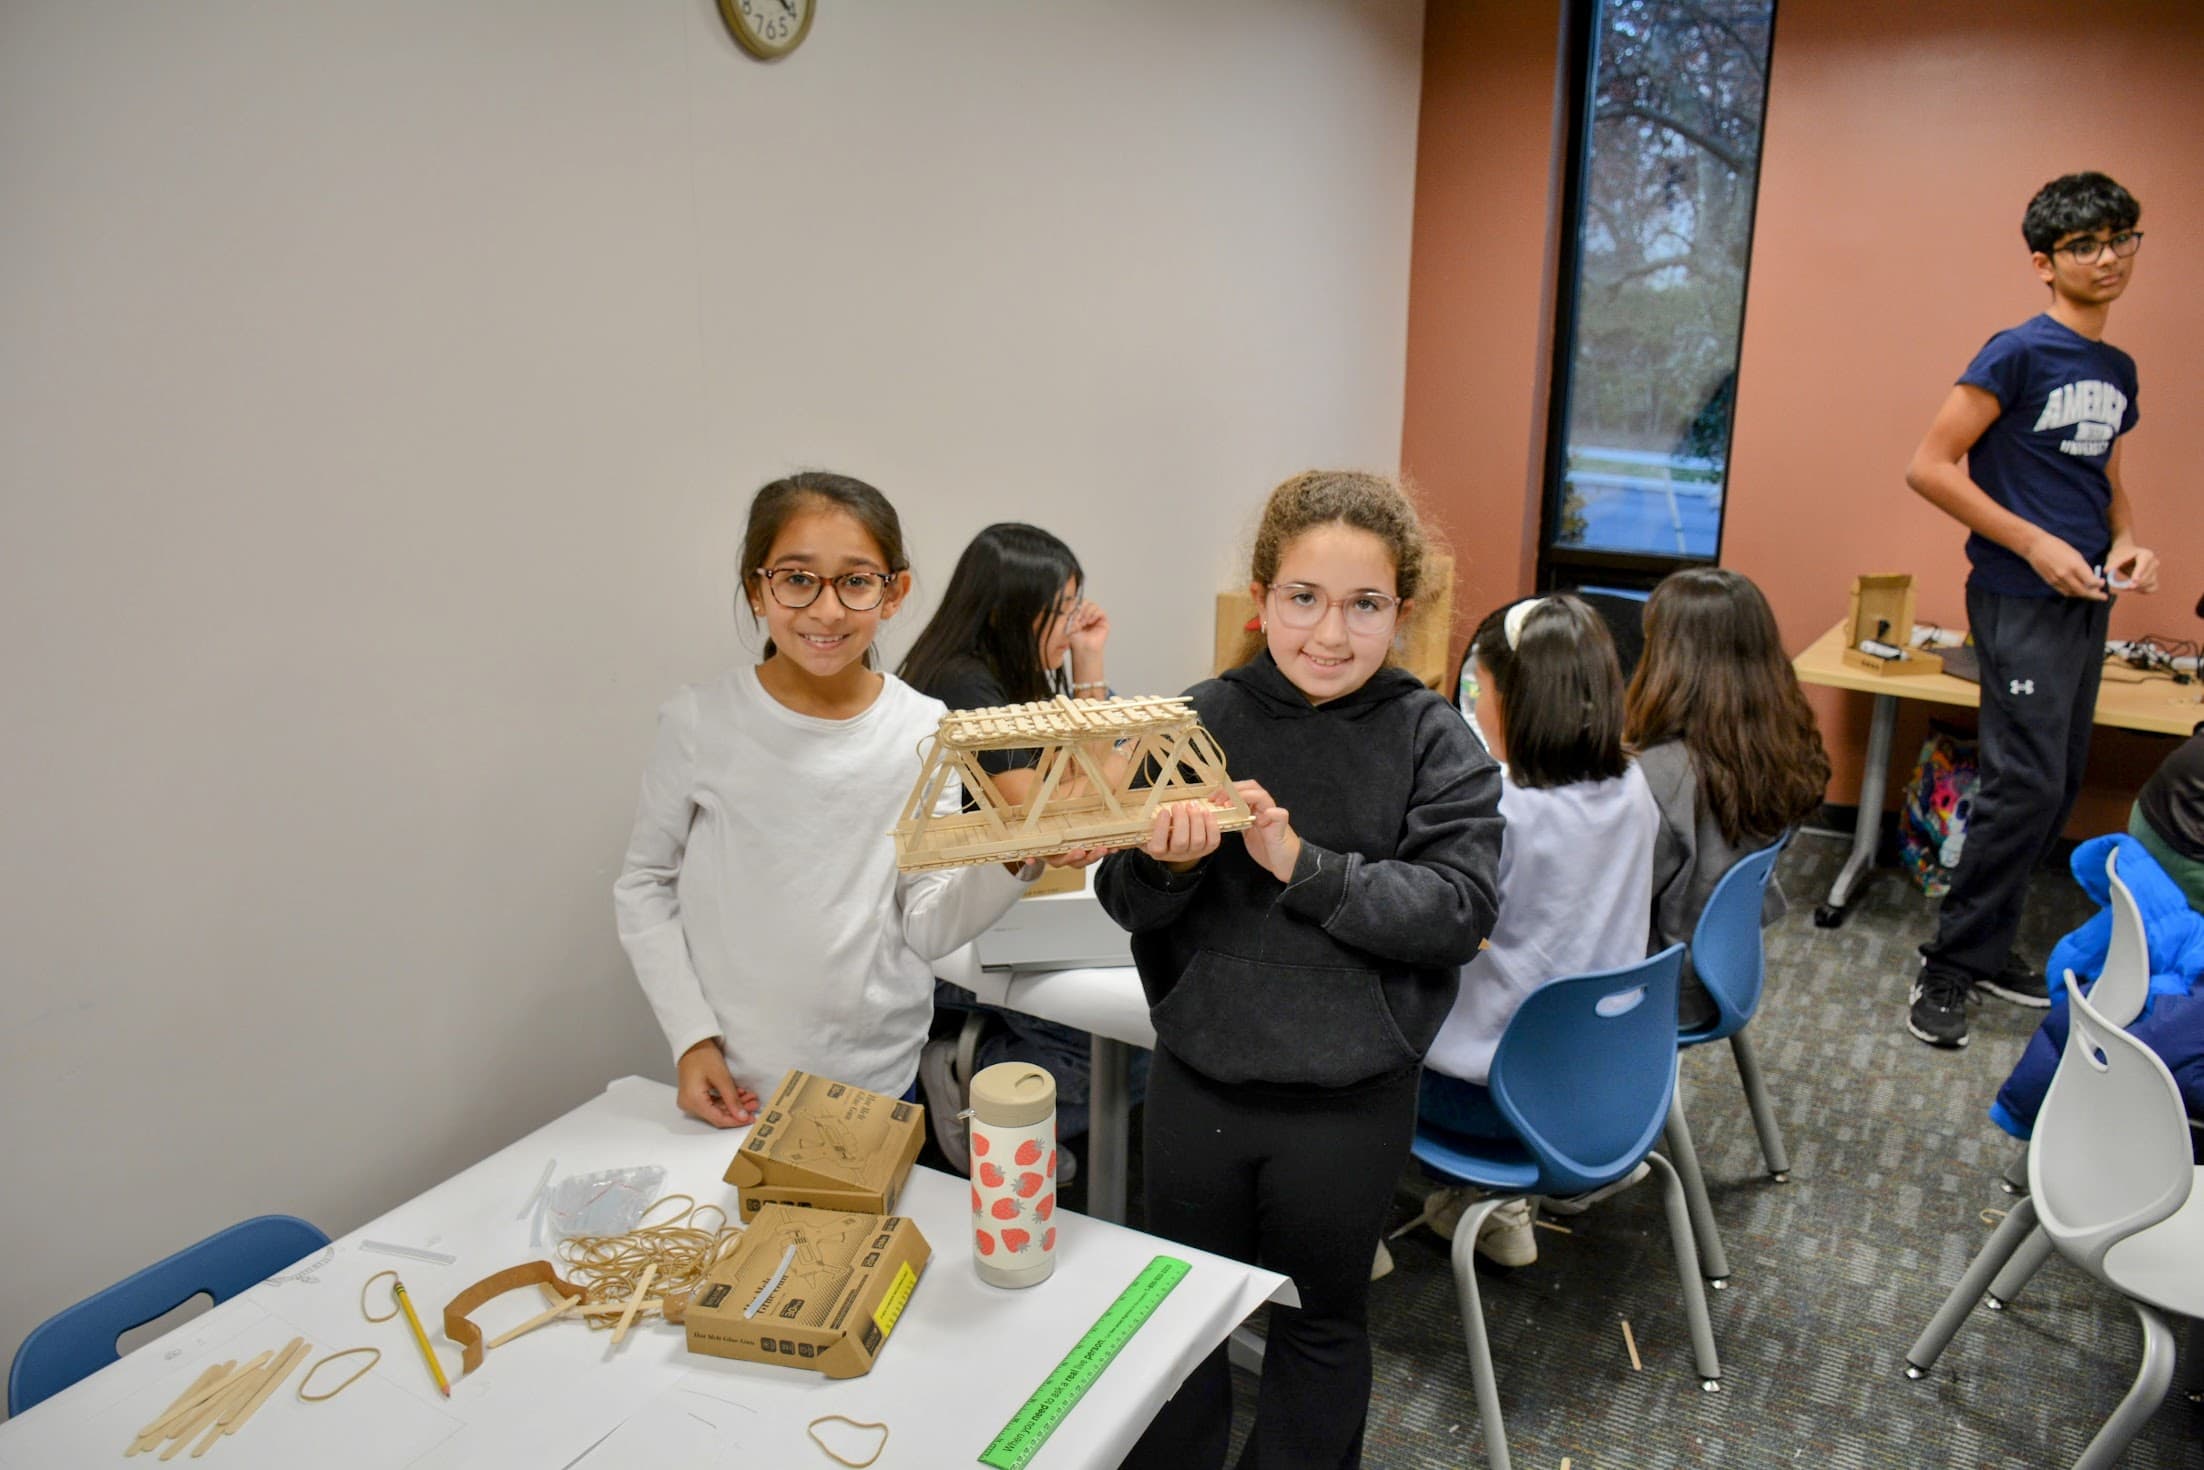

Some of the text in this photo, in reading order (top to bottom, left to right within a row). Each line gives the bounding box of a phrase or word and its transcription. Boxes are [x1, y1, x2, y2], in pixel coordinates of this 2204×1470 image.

[754, 13, 764, 34] 7
[766, 20, 776, 39] 6
[779, 16, 788, 37] 5
[1002, 1432, 1025, 1452] When
[1024, 1421, 1035, 1434] you
[1031, 1404, 1049, 1422] need
[1044, 1397, 1055, 1405] to
[1065, 1368, 1080, 1382] real
